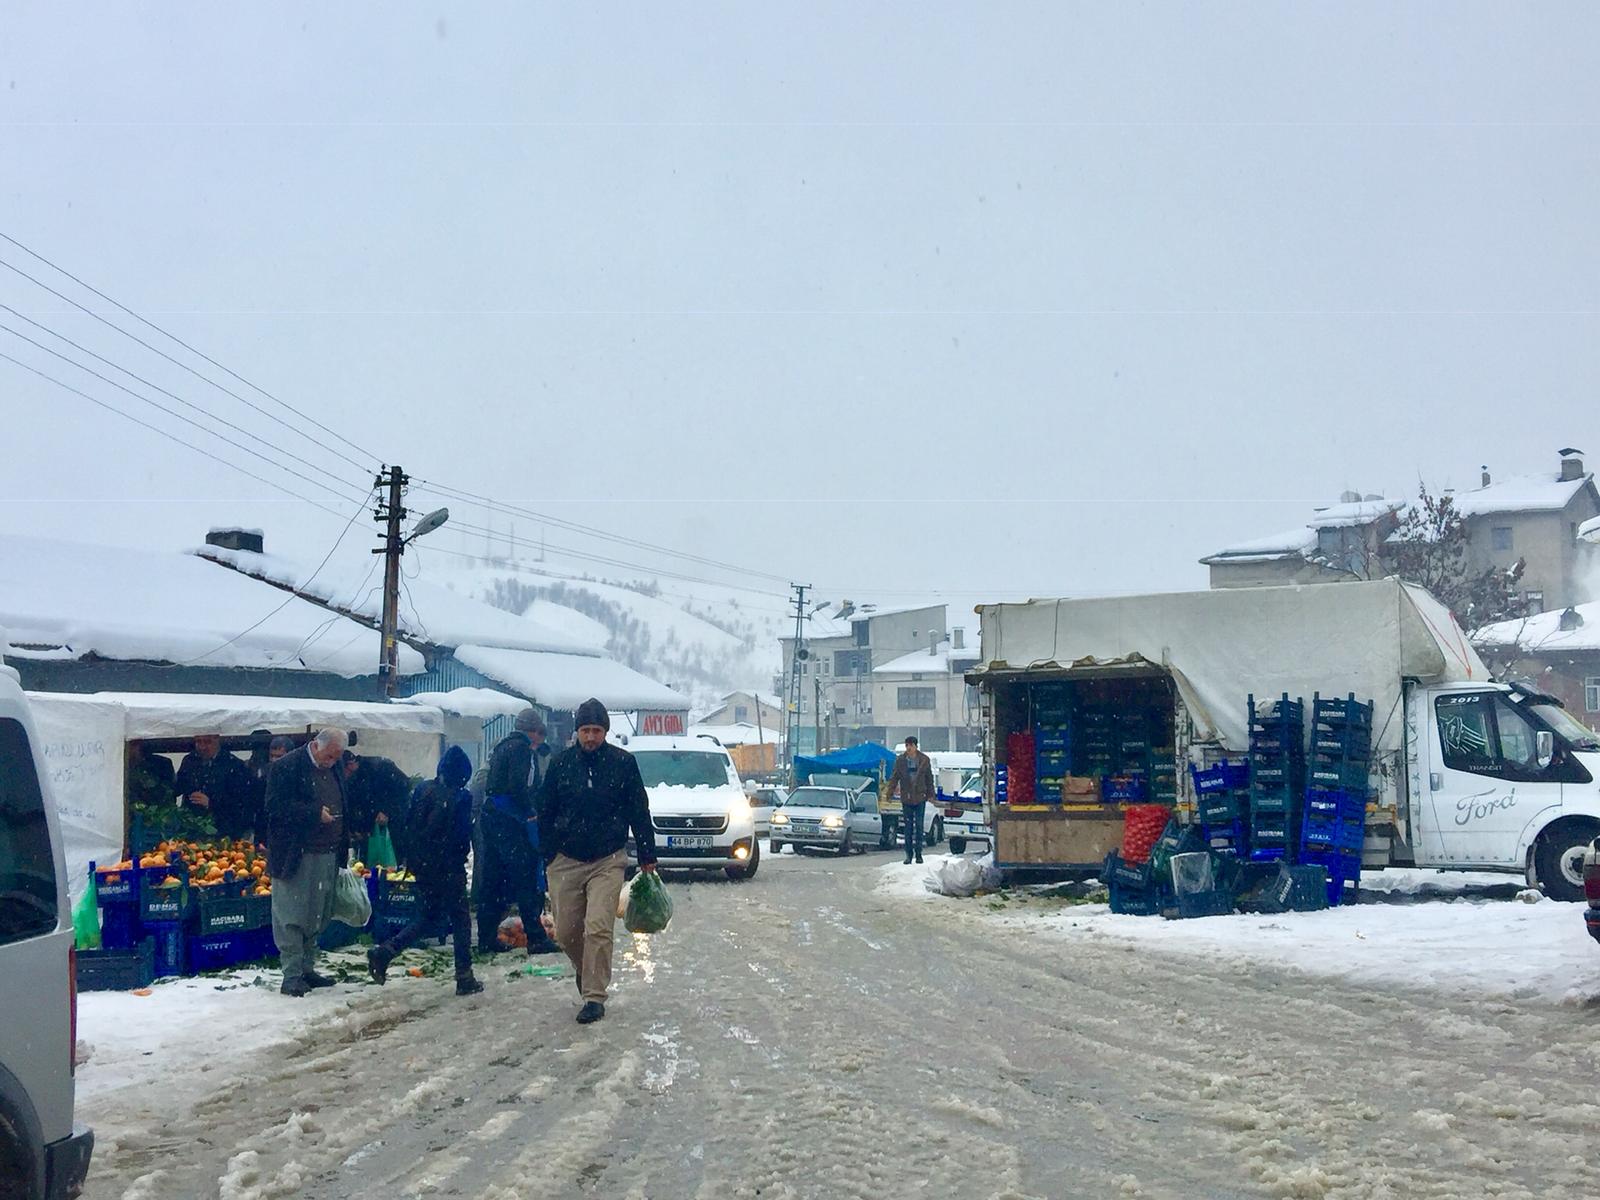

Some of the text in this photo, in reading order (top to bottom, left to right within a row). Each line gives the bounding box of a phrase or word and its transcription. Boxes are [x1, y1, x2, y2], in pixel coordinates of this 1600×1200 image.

[1450, 696, 1479, 704] 2013
[1455, 787, 1516, 826] Ford
[672, 837, 682, 846] 44
[684, 837, 696, 846] BP
